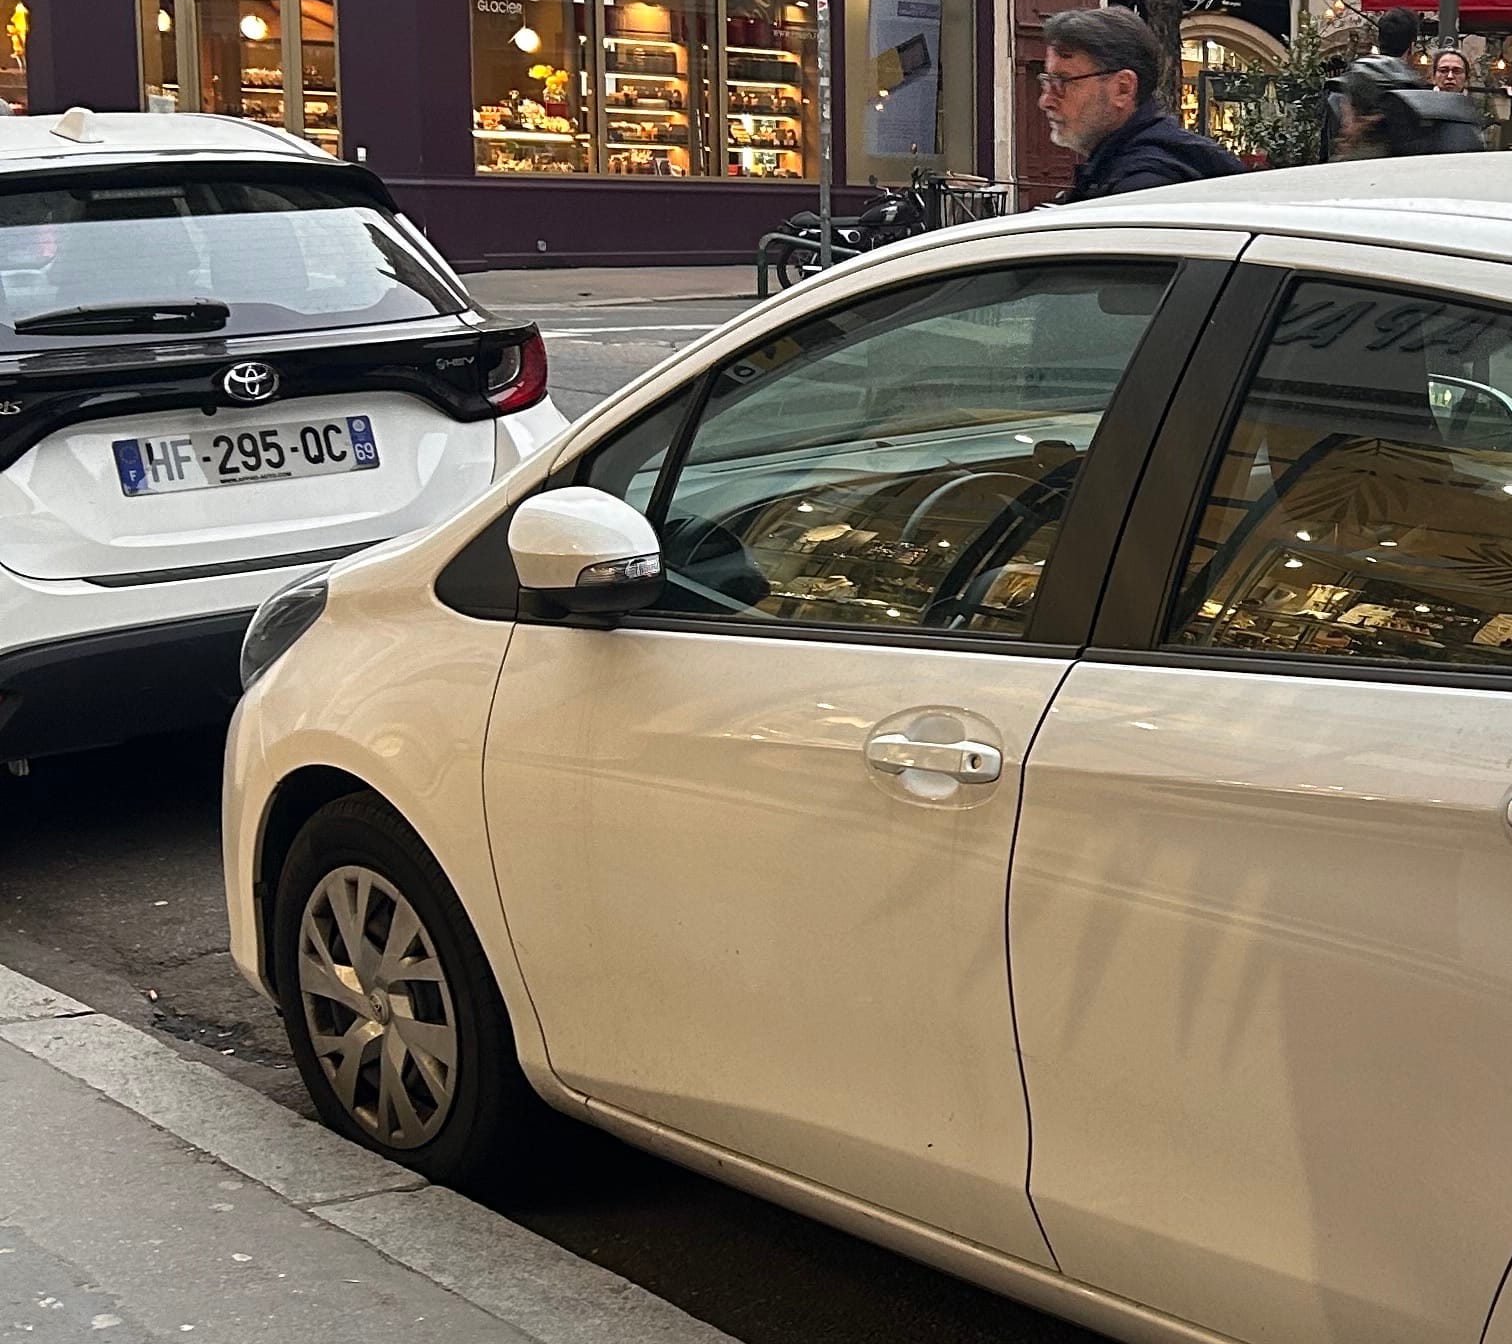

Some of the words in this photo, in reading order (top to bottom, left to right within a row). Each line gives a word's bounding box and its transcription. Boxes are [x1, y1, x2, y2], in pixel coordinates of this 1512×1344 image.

[145, 423, 348, 483] HF-295-QC
[354, 442, 375, 461] 69
[129, 469, 137, 482] F
